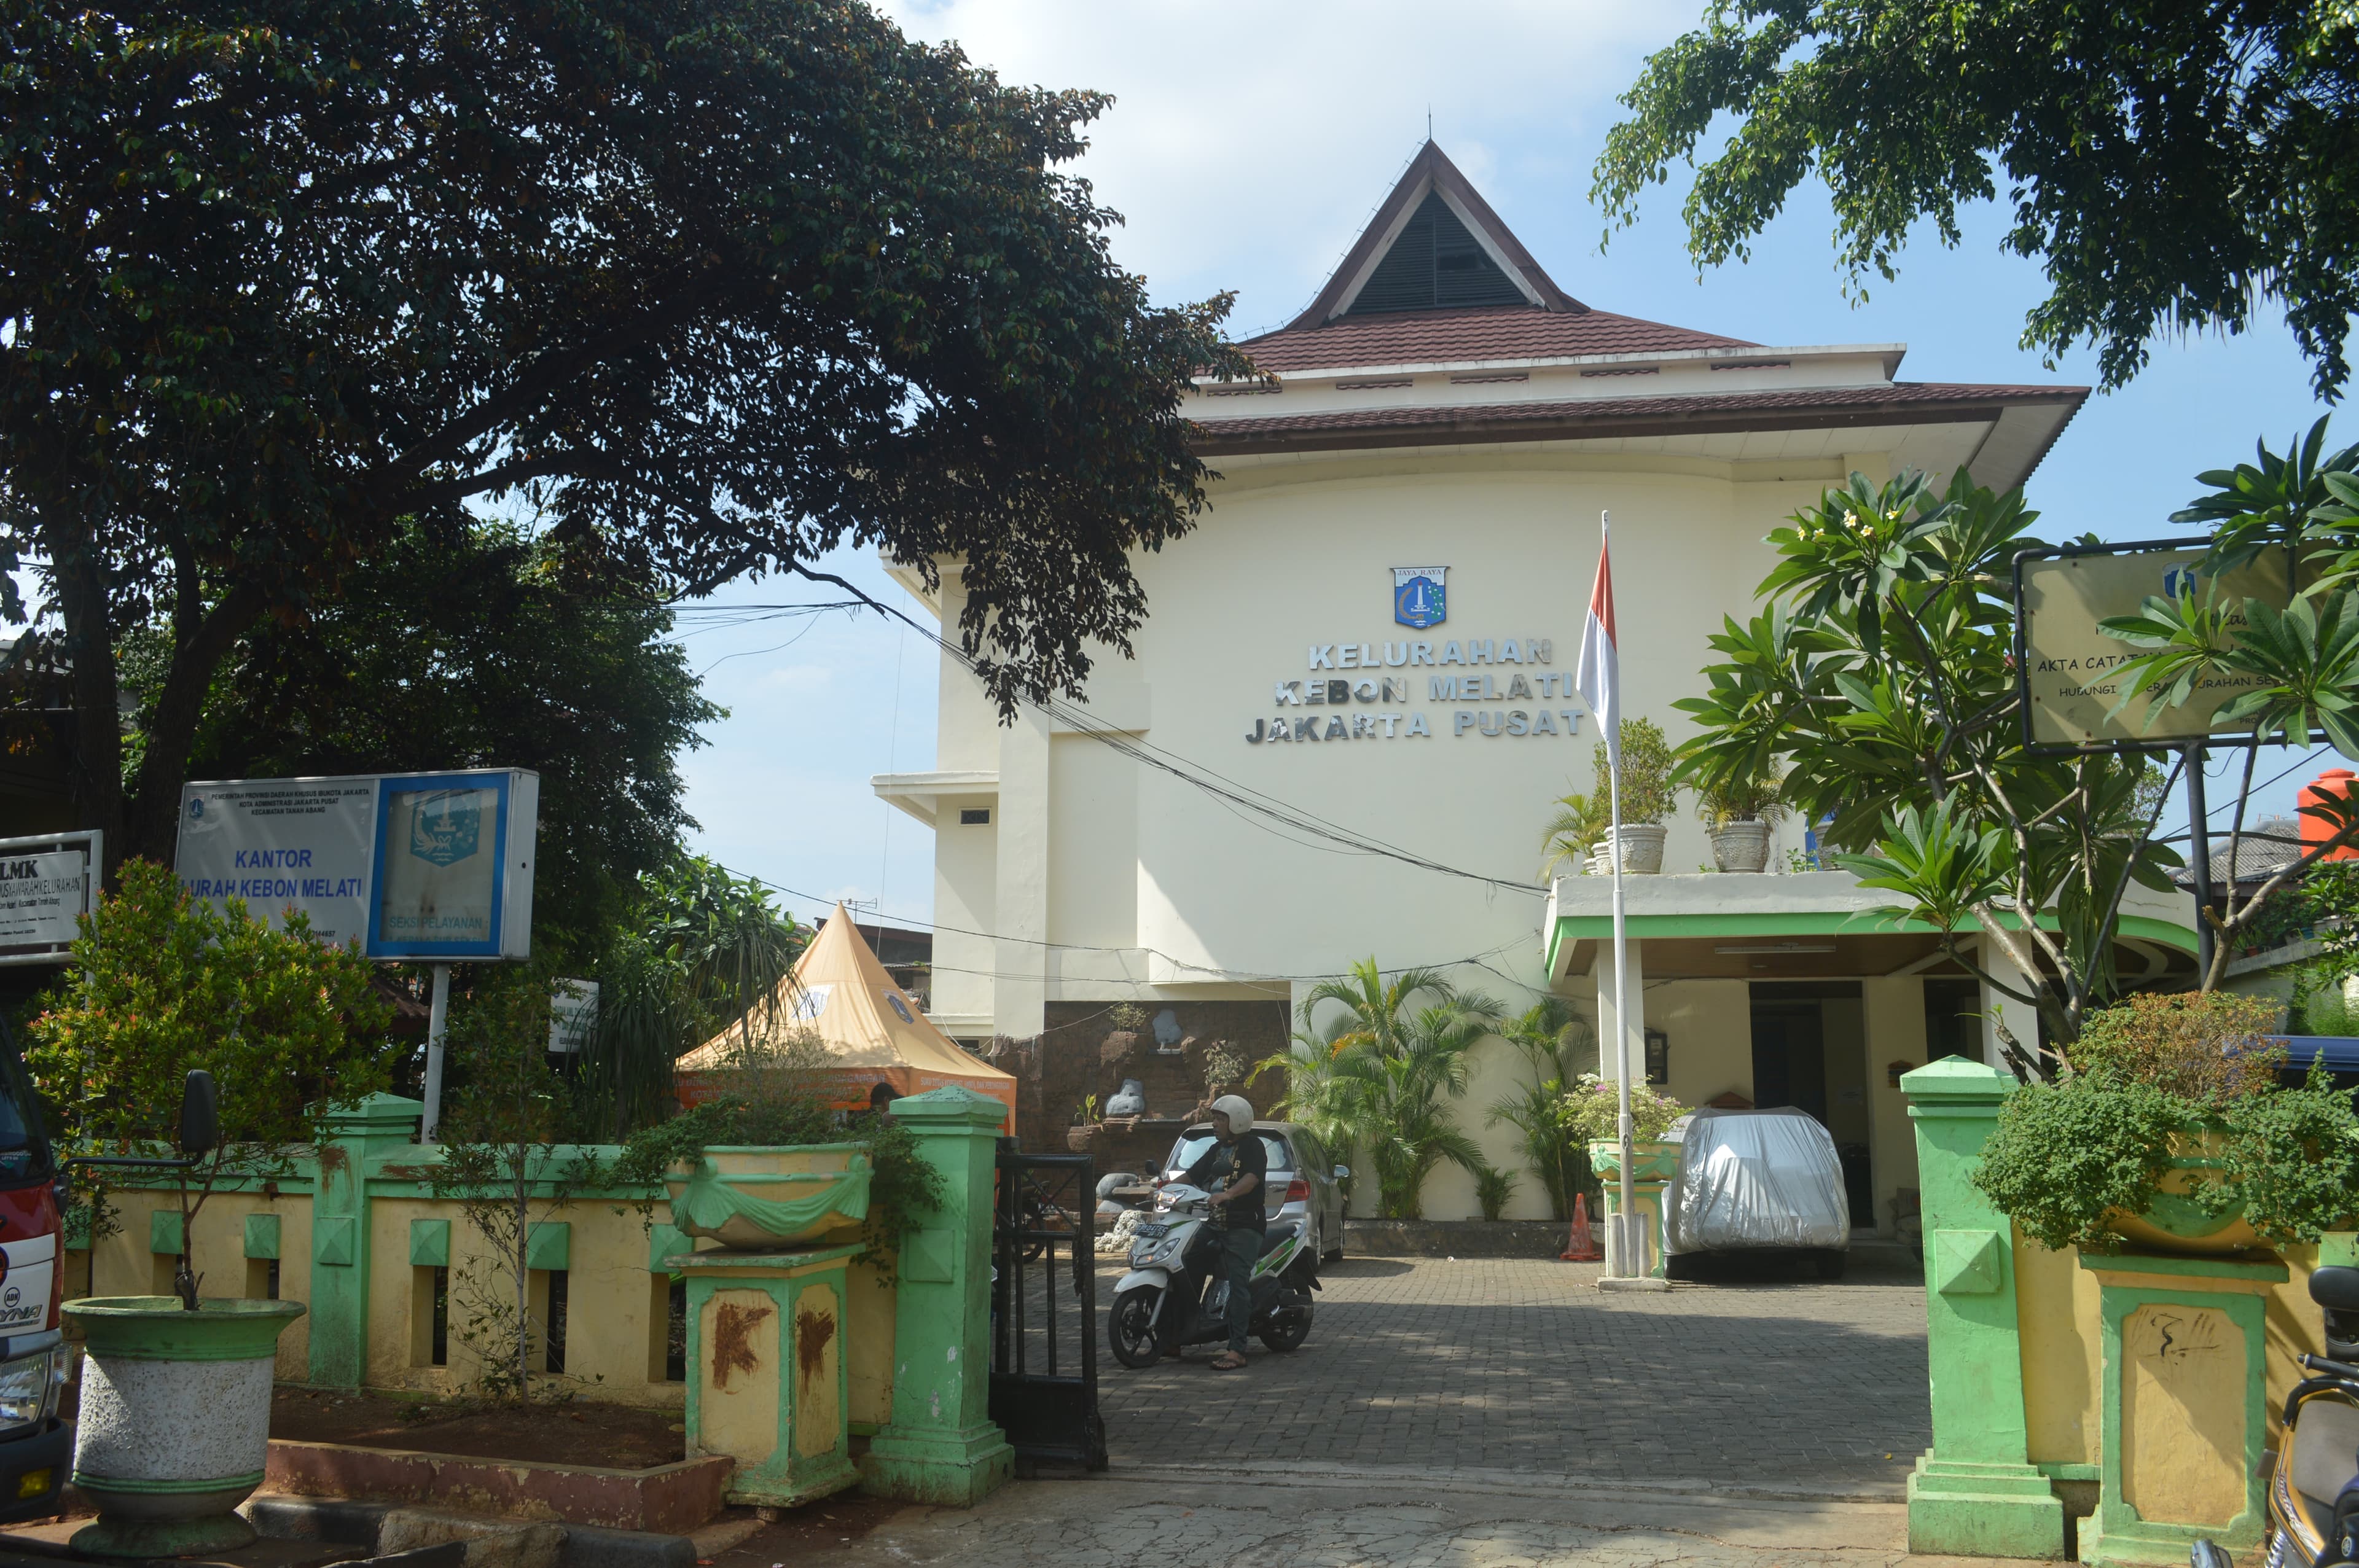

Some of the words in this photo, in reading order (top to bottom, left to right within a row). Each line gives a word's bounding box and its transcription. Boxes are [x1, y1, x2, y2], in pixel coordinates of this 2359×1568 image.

[1309, 639, 1552, 670] KELURAHAN
[2038, 659, 2079, 673] AKTA
[1275, 677, 1406, 706] KEBON
[1429, 672, 1573, 701] MELATI
[2059, 685, 2116, 697] HUBUNGI
[1245, 712, 1431, 745] JAKARTA
[1453, 709, 1584, 736] PUSAT
[251, 808, 285, 816] KECAMATAN
[235, 849, 312, 868] KANTOR
[240, 879, 297, 897] KEBON
[301, 878, 362, 898] MELATI
[388, 916, 420, 929] SEKSI
[422, 916, 482, 929] PELAYANAN
[6, 1292, 18, 1301] ADK
[0, 1304, 43, 1322] YNA
